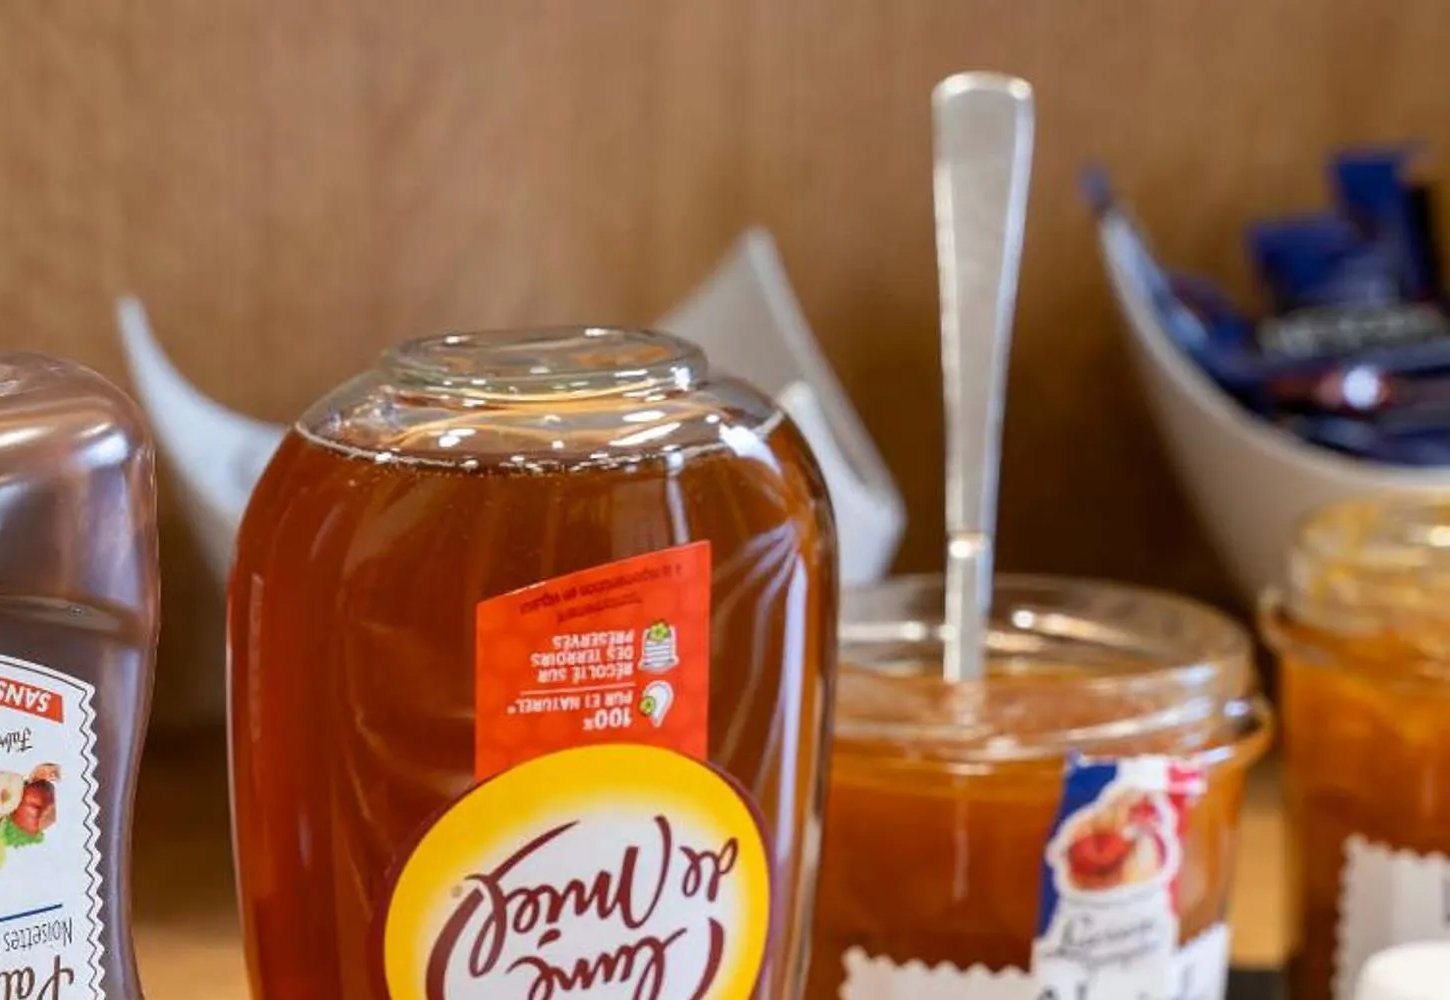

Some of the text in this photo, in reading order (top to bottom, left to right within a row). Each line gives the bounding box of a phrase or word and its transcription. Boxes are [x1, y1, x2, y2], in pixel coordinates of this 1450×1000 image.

[530, 646, 634, 667] DES TERROIRS
[537, 662, 634, 684] RÉCOLTÉ SUR
[584, 693, 601, 708] ET
[605, 690, 634, 705] PUR
[679, 836, 739, 902] de
[3, 918, 74, 953] Noisettes
